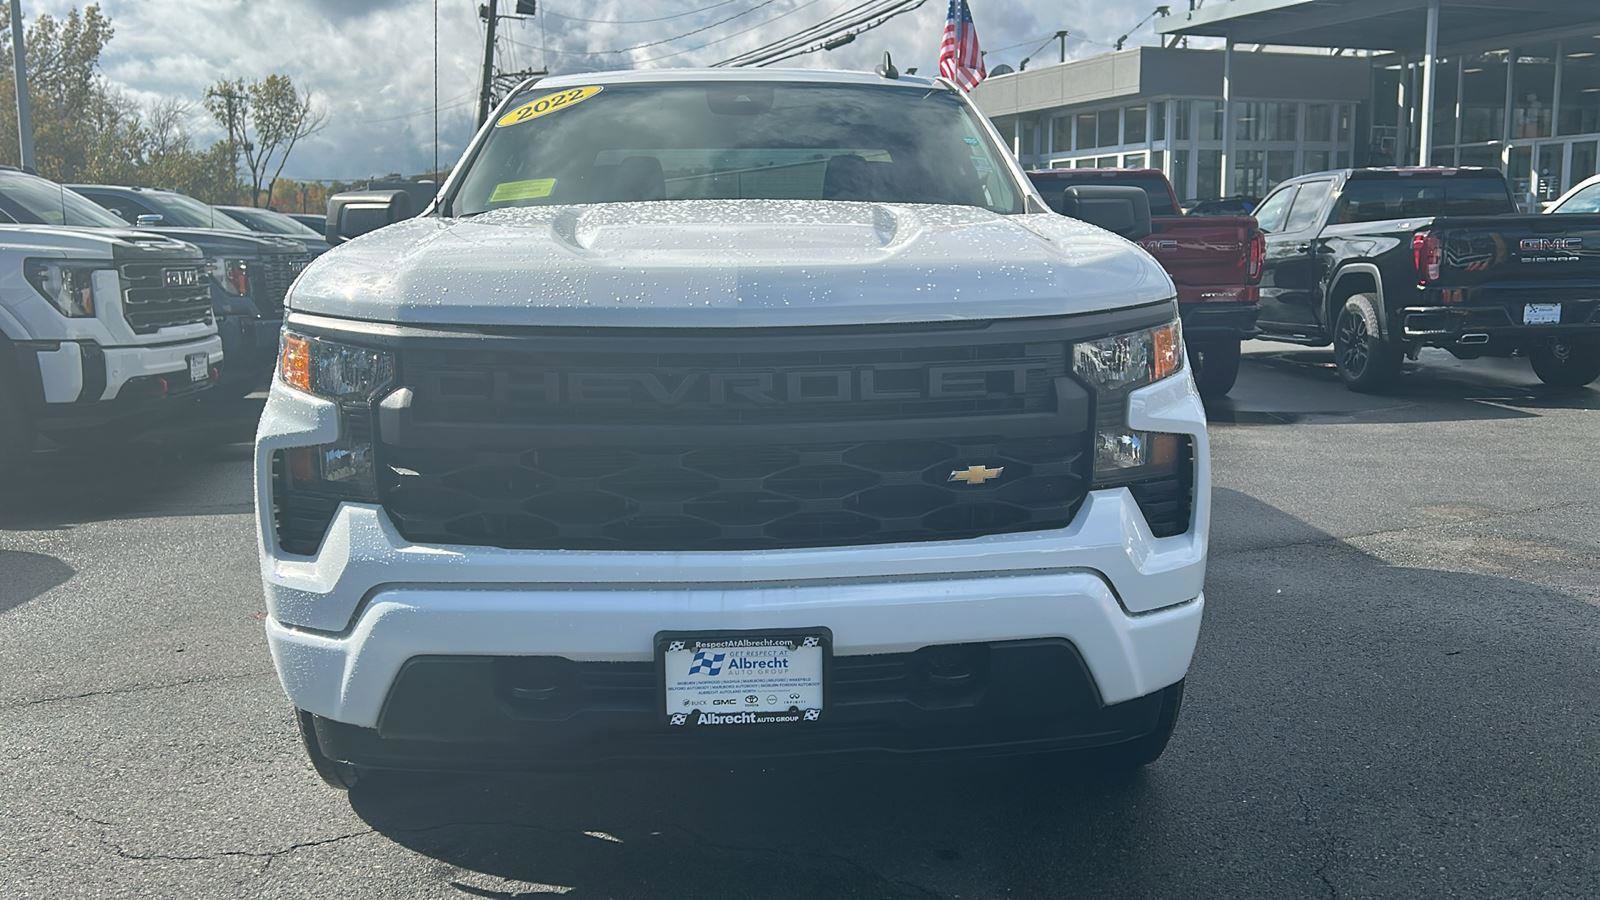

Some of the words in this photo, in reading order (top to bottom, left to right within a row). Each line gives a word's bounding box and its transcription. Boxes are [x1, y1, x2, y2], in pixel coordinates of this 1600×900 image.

[517, 89, 584, 120] 2022
[1520, 238, 1582, 250] GMC
[424, 362, 1047, 404] CHEVROLET
[695, 638, 793, 649] RespectAtAlbrecht.com
[728, 657, 788, 669] Albrecht
[697, 712, 756, 724] Albrecht
[776, 715, 799, 723] GROUP
